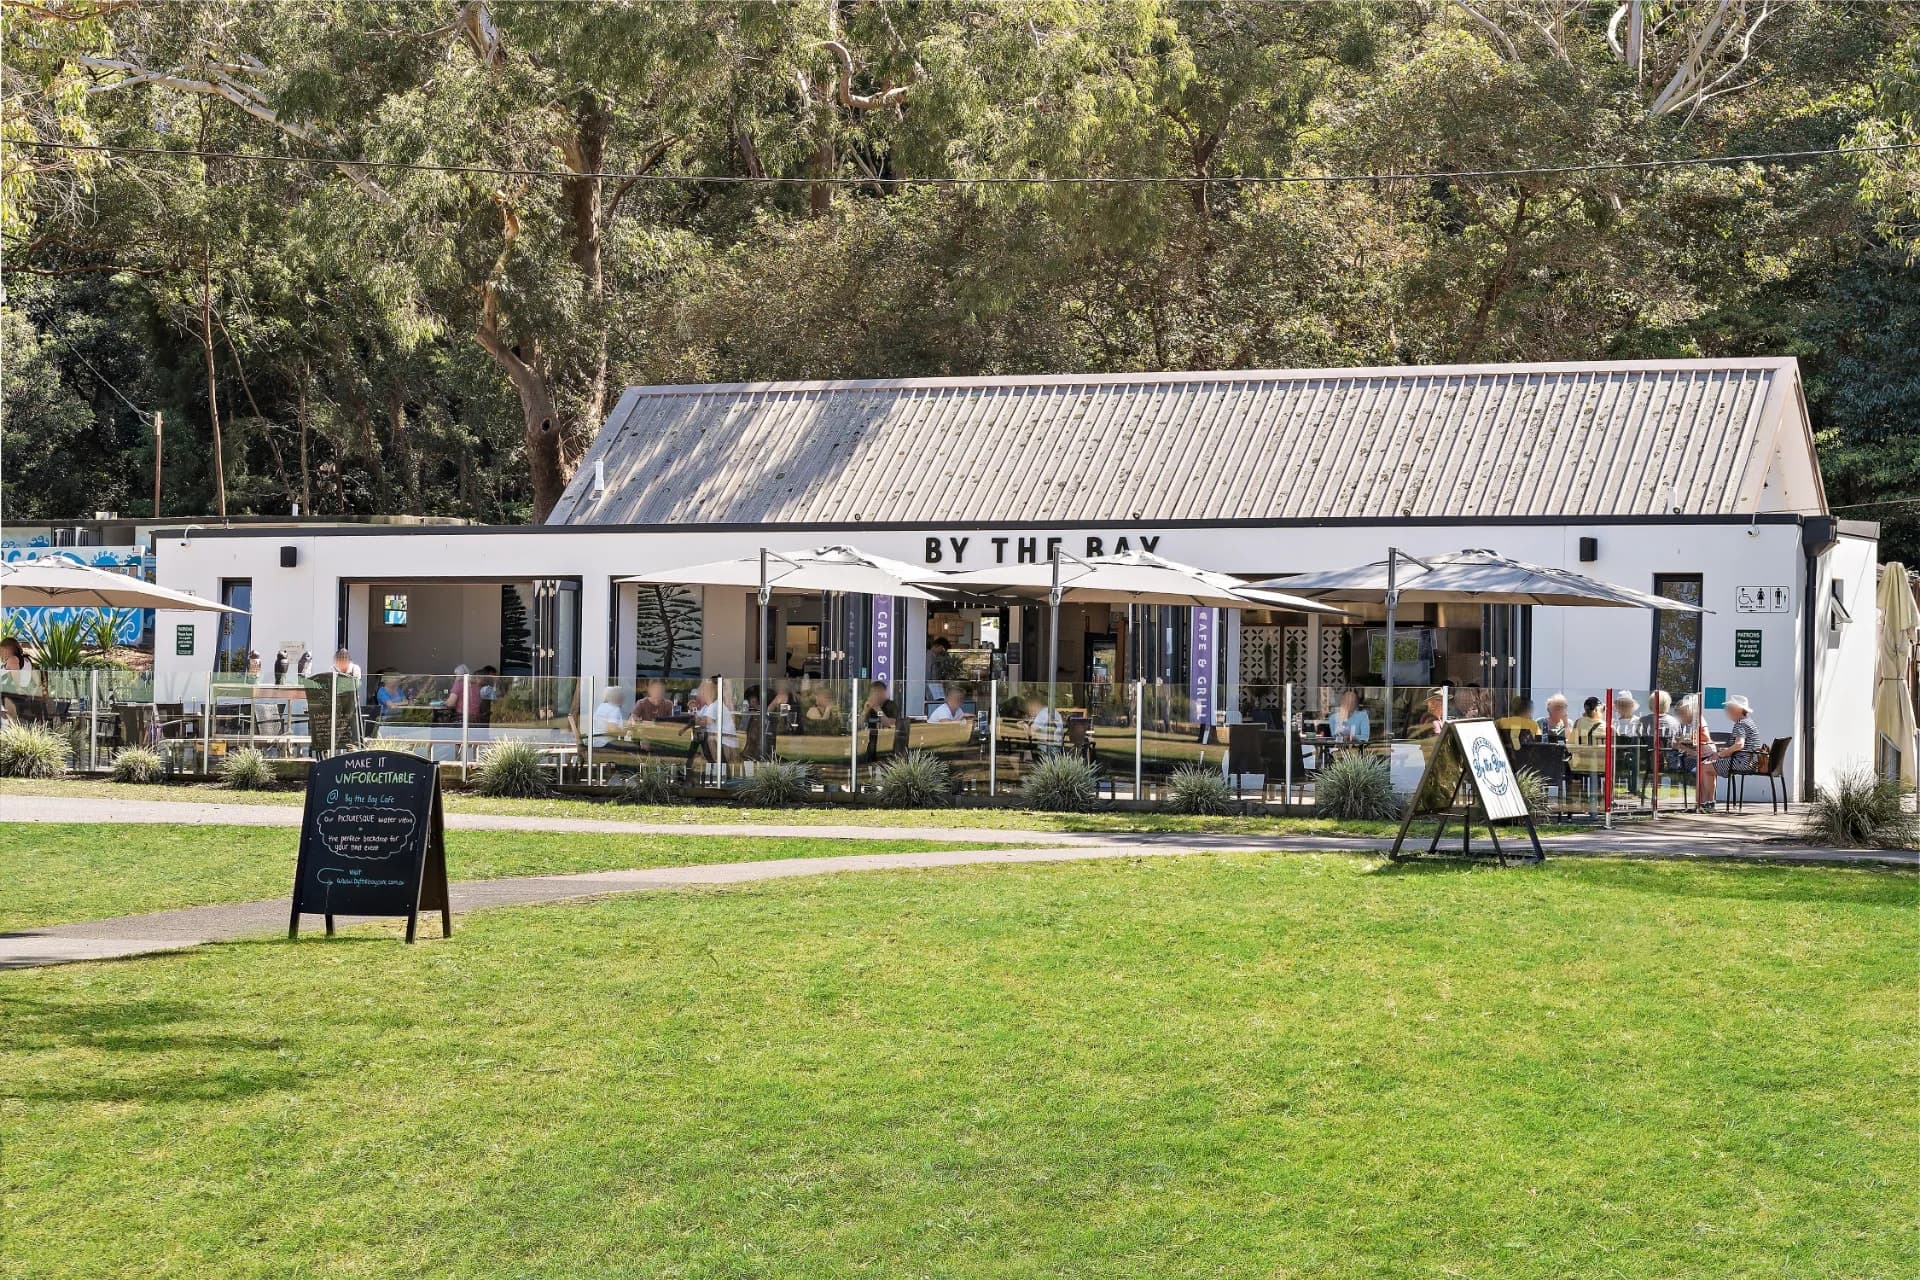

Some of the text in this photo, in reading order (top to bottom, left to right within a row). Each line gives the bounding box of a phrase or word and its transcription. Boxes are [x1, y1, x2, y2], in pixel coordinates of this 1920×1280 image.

[925, 537, 969, 563] BY
[1086, 536, 1160, 558] BAY
[878, 611, 888, 648] CAFE
[878, 655, 887, 664] &
[1197, 612, 1208, 720] CAFE & GRILL
[345, 756, 388, 769] MAKE IT
[335, 771, 416, 785] UNFORGETTABLE
[327, 789, 339, 804] @
[354, 793, 365, 803] the
[337, 814, 375, 823] PICTURESQUE
